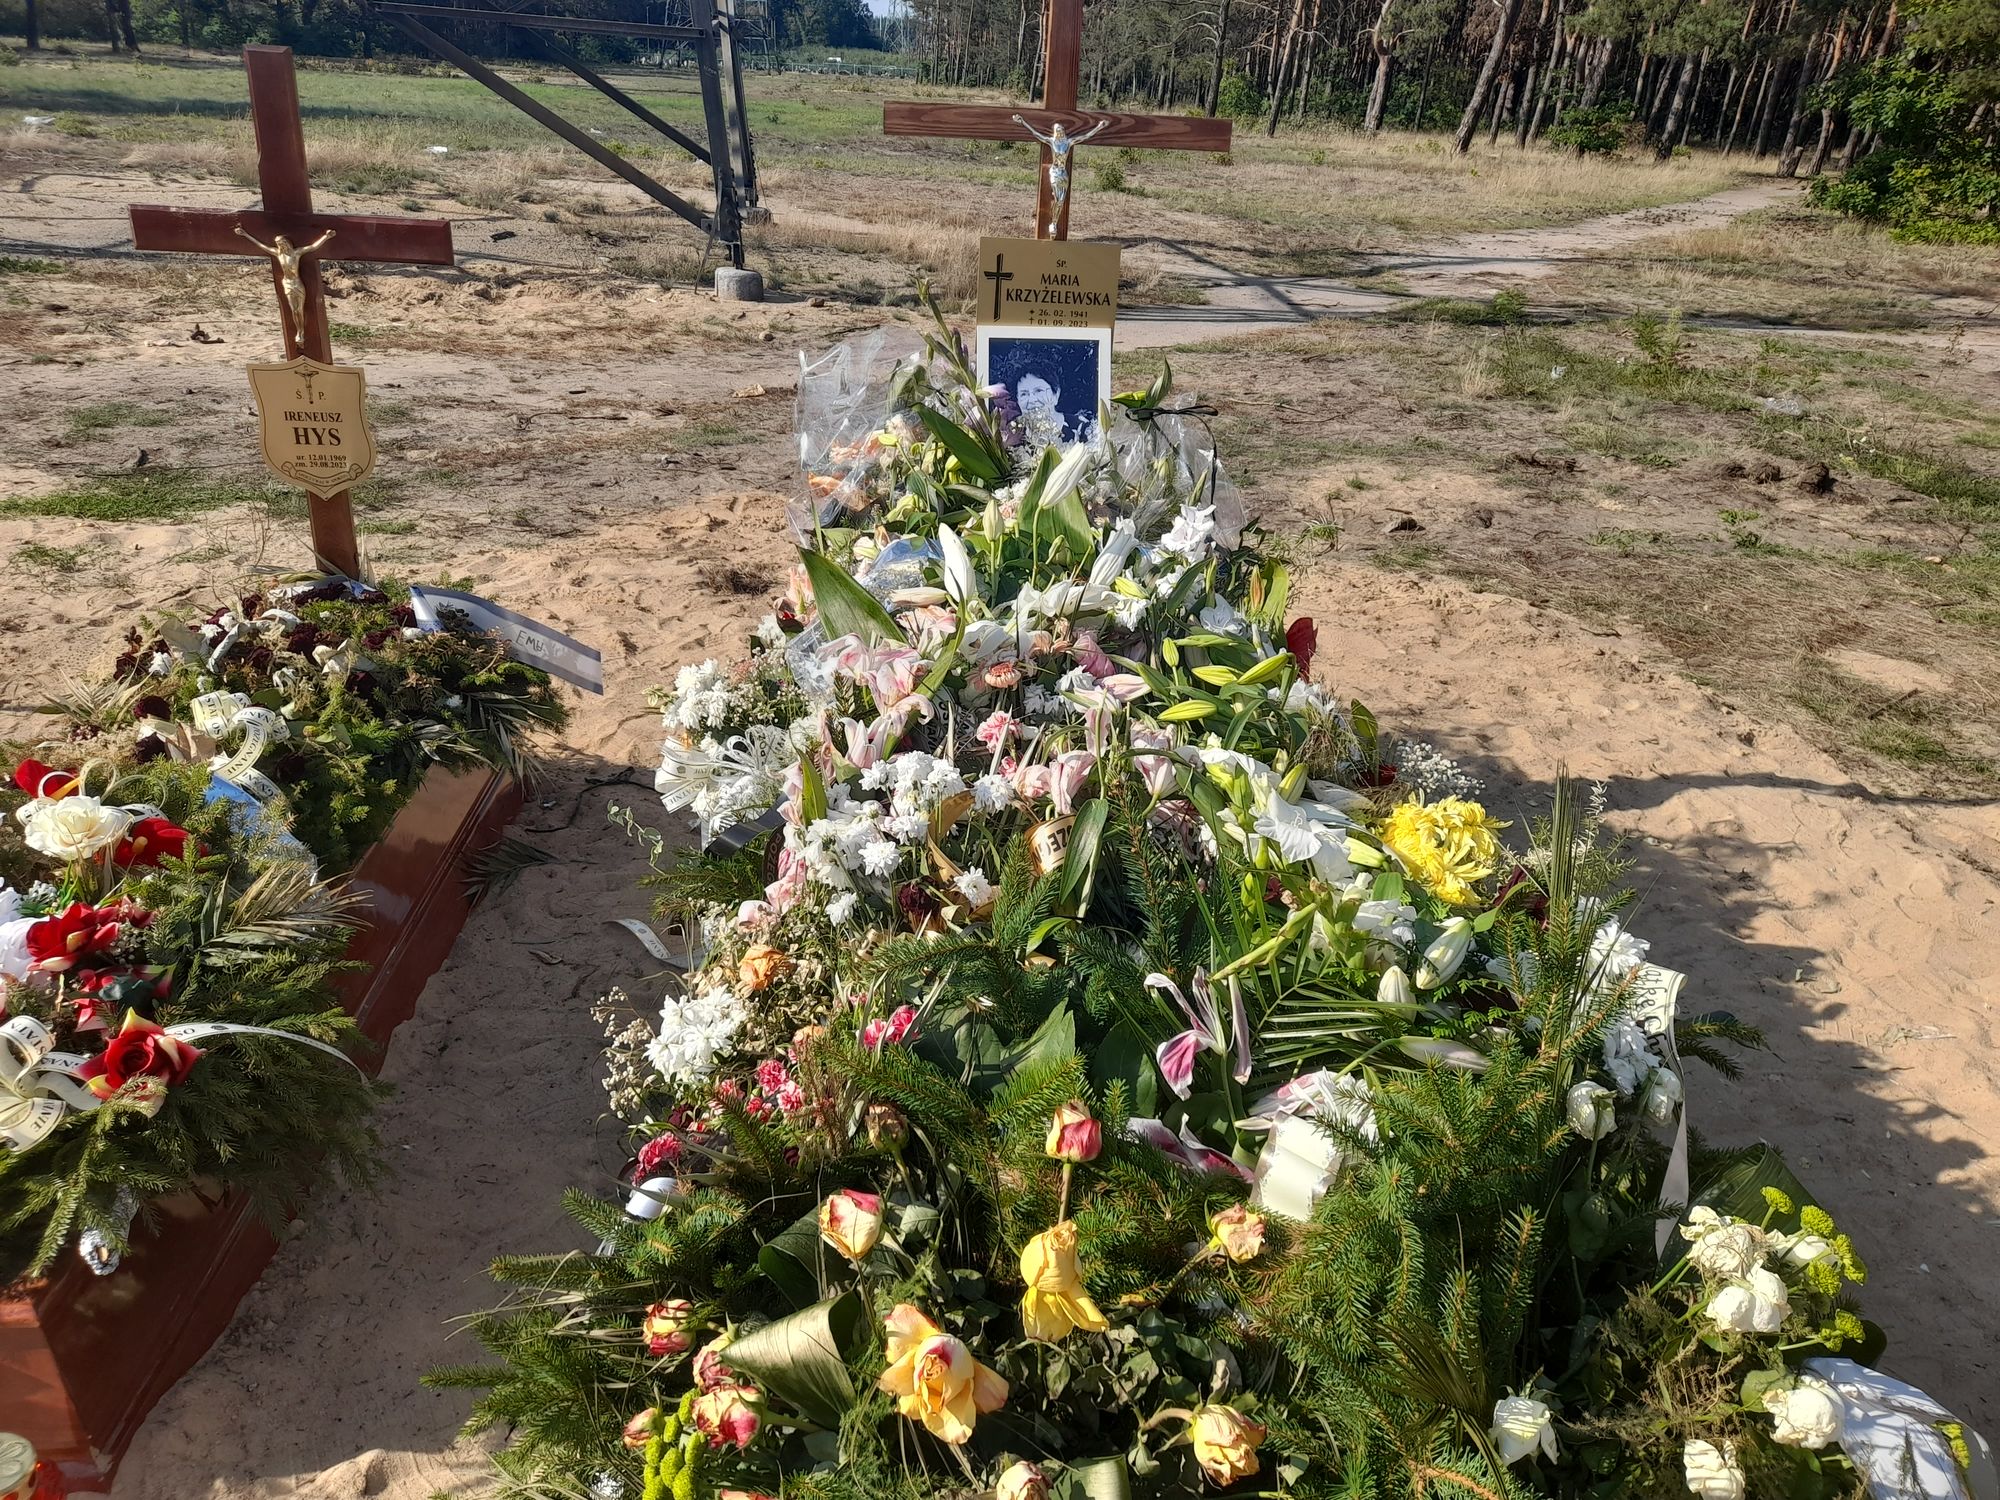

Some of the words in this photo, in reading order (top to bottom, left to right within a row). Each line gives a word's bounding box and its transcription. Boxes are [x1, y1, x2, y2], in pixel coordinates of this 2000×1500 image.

[1040, 273, 1080, 287] MARIA
[1006, 286, 1112, 306] KRZYŻELEWSKA
[284, 410, 343, 423] IRENEUSZ
[292, 426, 342, 447] HYS
